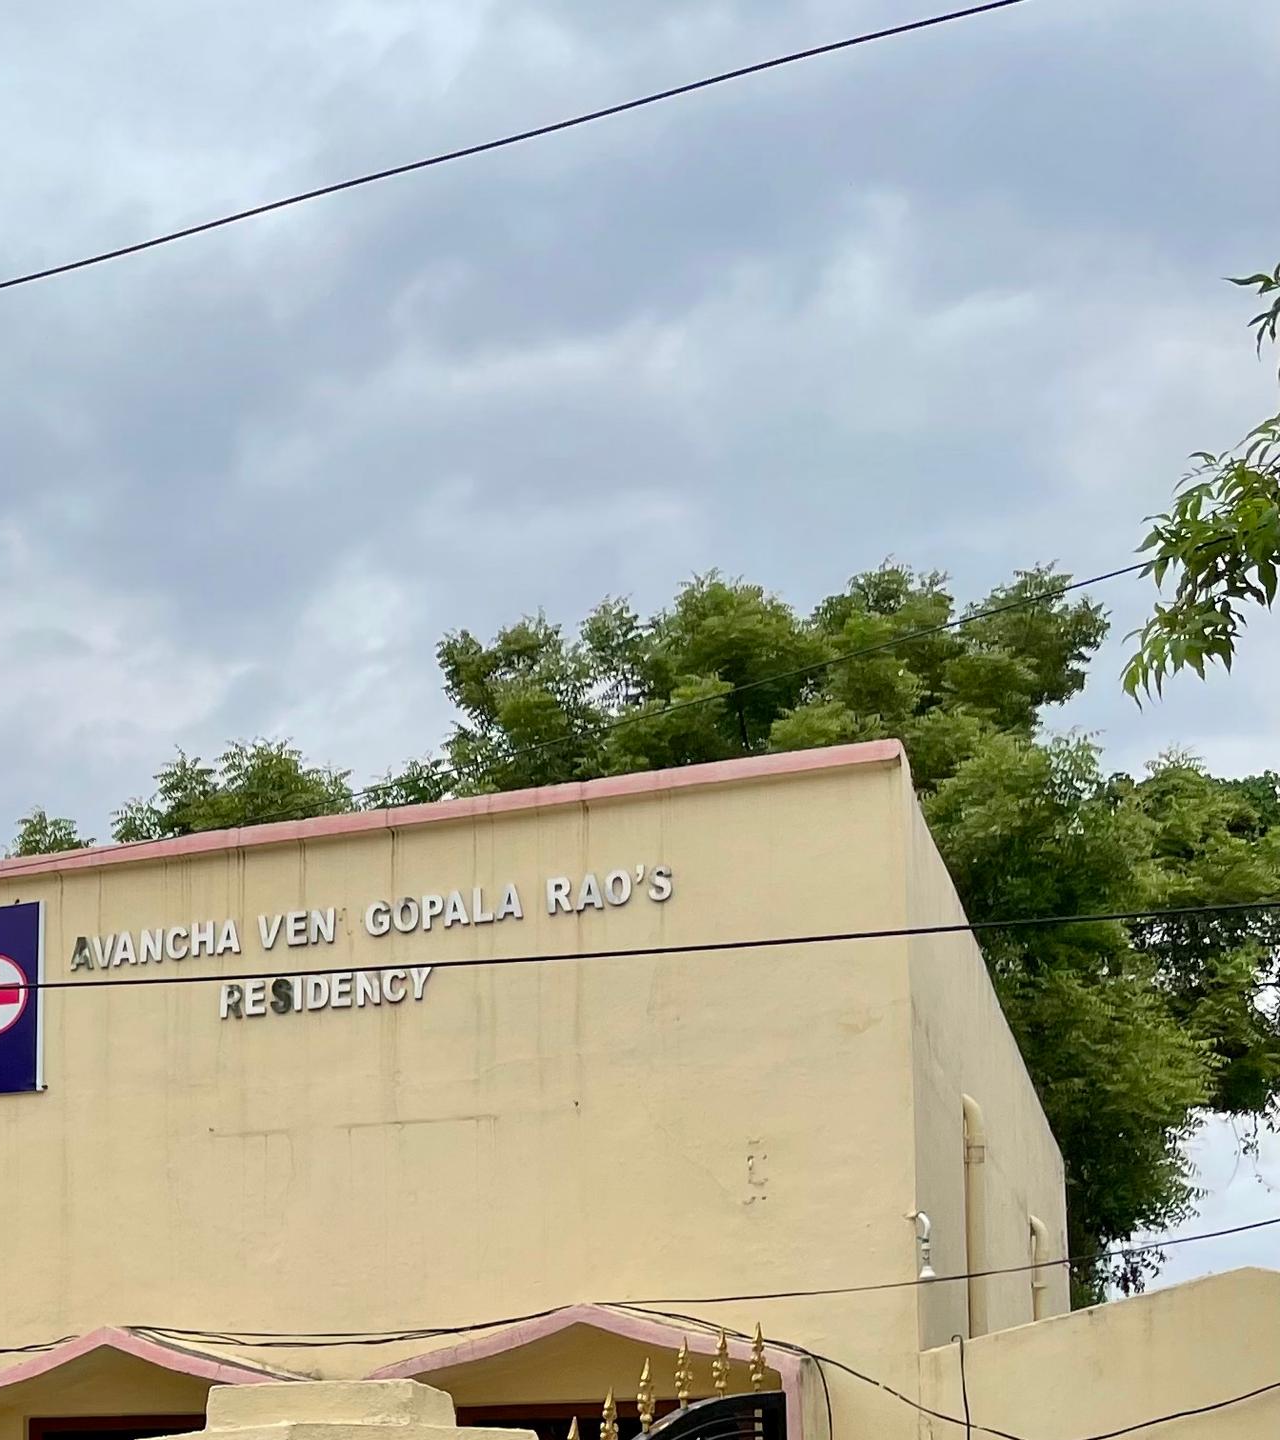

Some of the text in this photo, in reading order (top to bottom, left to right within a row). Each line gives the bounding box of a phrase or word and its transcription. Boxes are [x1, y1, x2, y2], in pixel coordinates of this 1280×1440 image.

[71, 918, 241, 971] AVANCHA
[257, 908, 336, 949] VEN
[366, 883, 524, 937] GOPALA
[219, 967, 437, 1019] RESIDENCY
